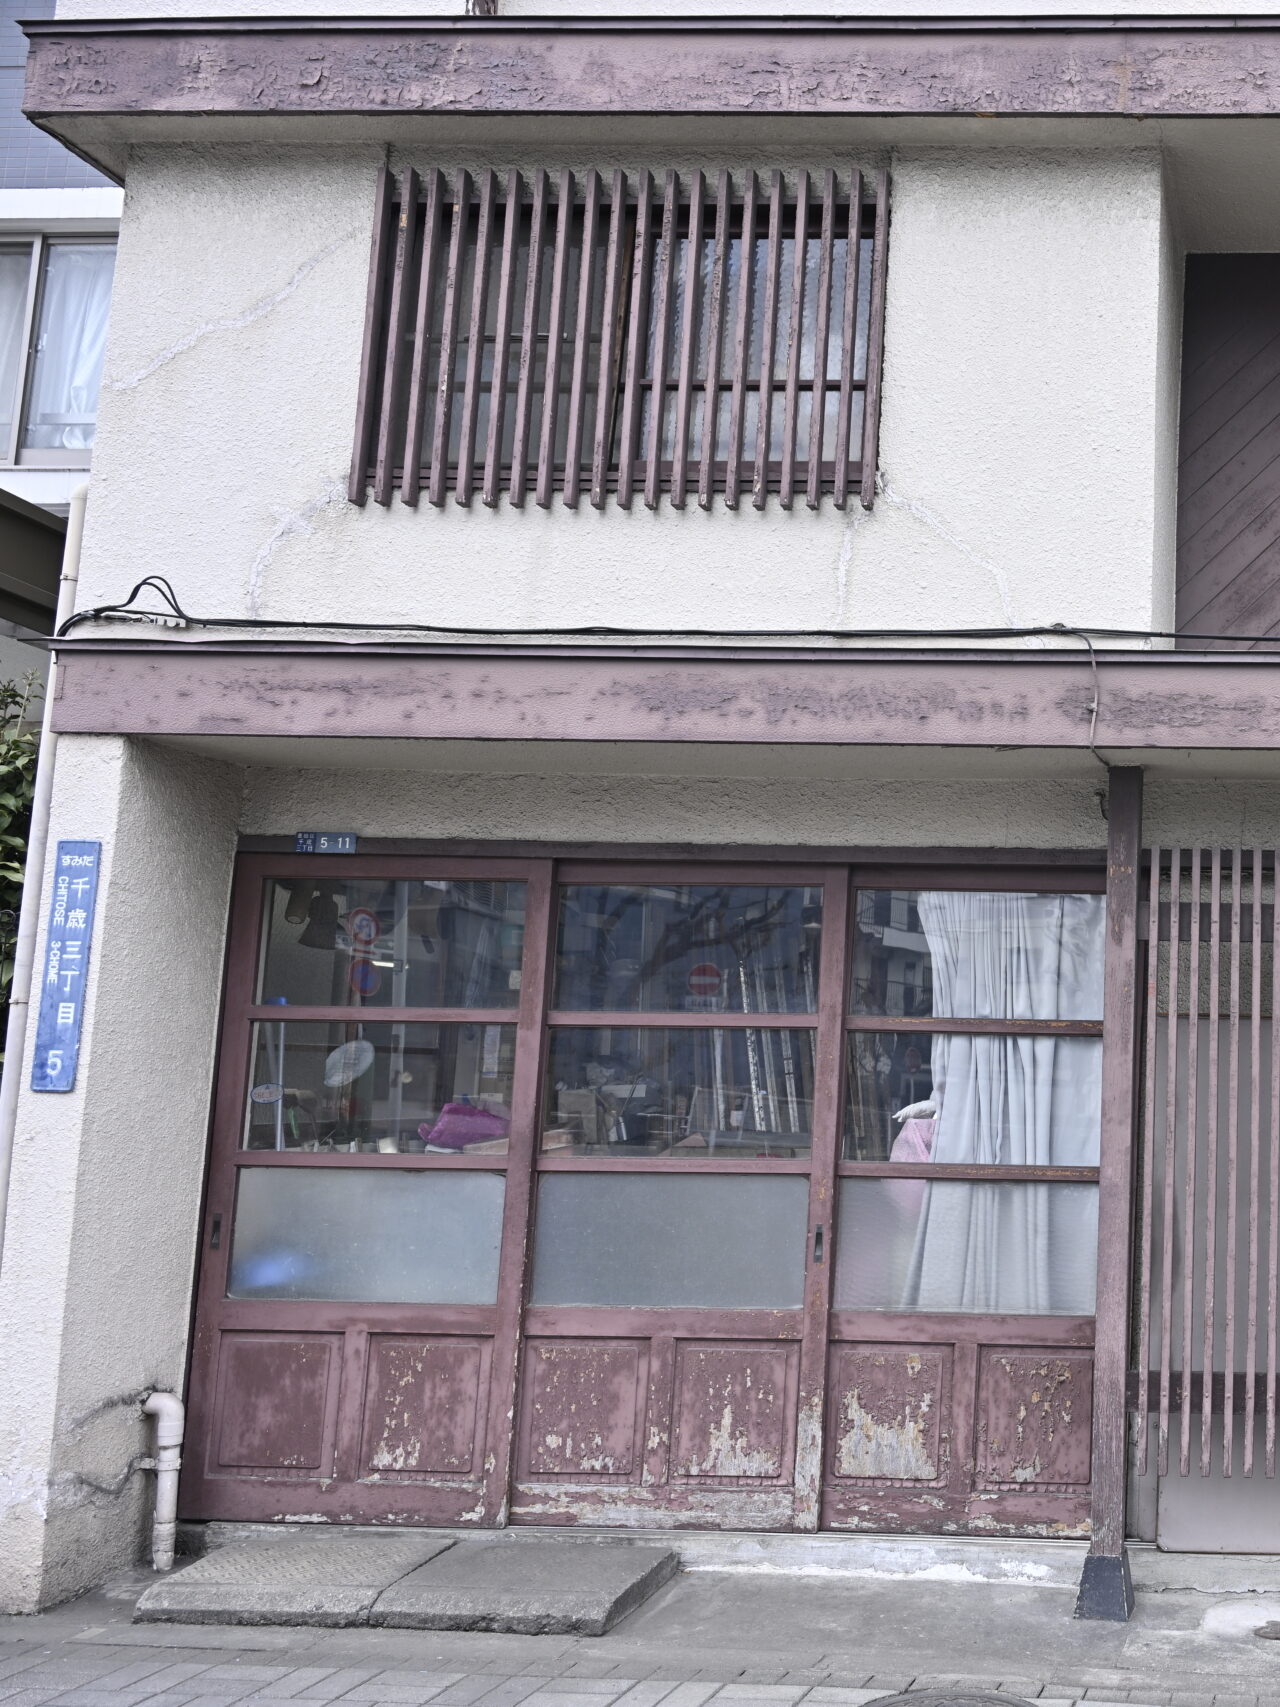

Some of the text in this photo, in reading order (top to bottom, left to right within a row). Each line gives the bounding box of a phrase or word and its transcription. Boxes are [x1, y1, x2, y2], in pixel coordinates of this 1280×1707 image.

[320, 837, 351, 849] 5-11
[61, 854, 95, 867] すみだ
[53, 875, 69, 926] CHITOSE
[46, 877, 91, 1076] 千歳三丁目 5
